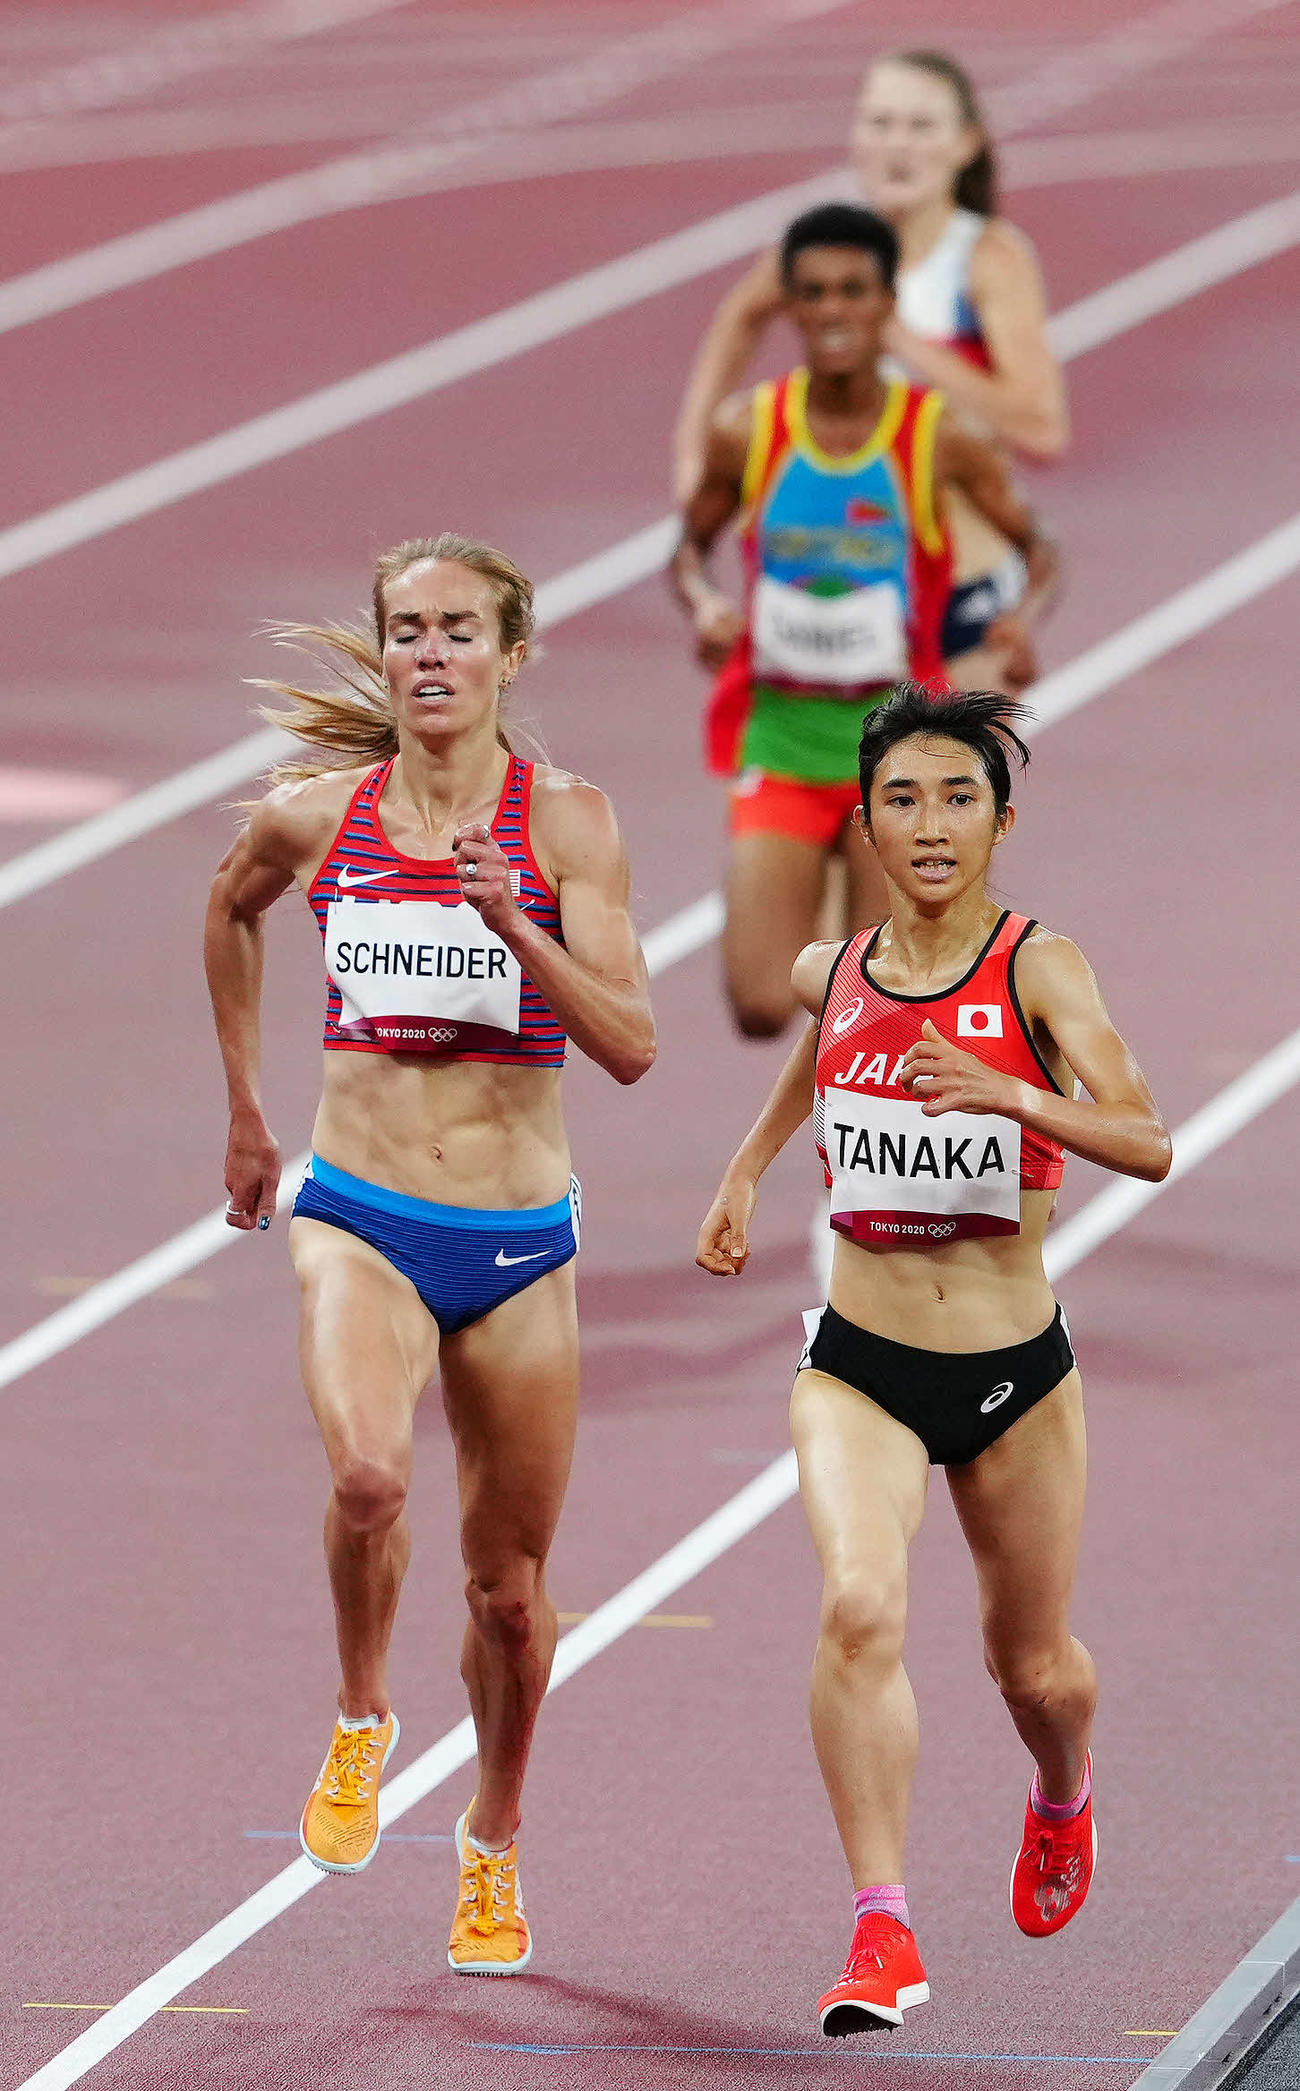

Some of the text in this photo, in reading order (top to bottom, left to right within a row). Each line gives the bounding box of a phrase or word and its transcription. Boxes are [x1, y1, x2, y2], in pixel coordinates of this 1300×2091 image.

[335, 941, 508, 979] SCHNEIDER
[375, 1027, 426, 1039] OKYO 2020
[833, 1122, 1006, 1180] TANAKA
[869, 1221, 925, 1235] TOKYO 2020
